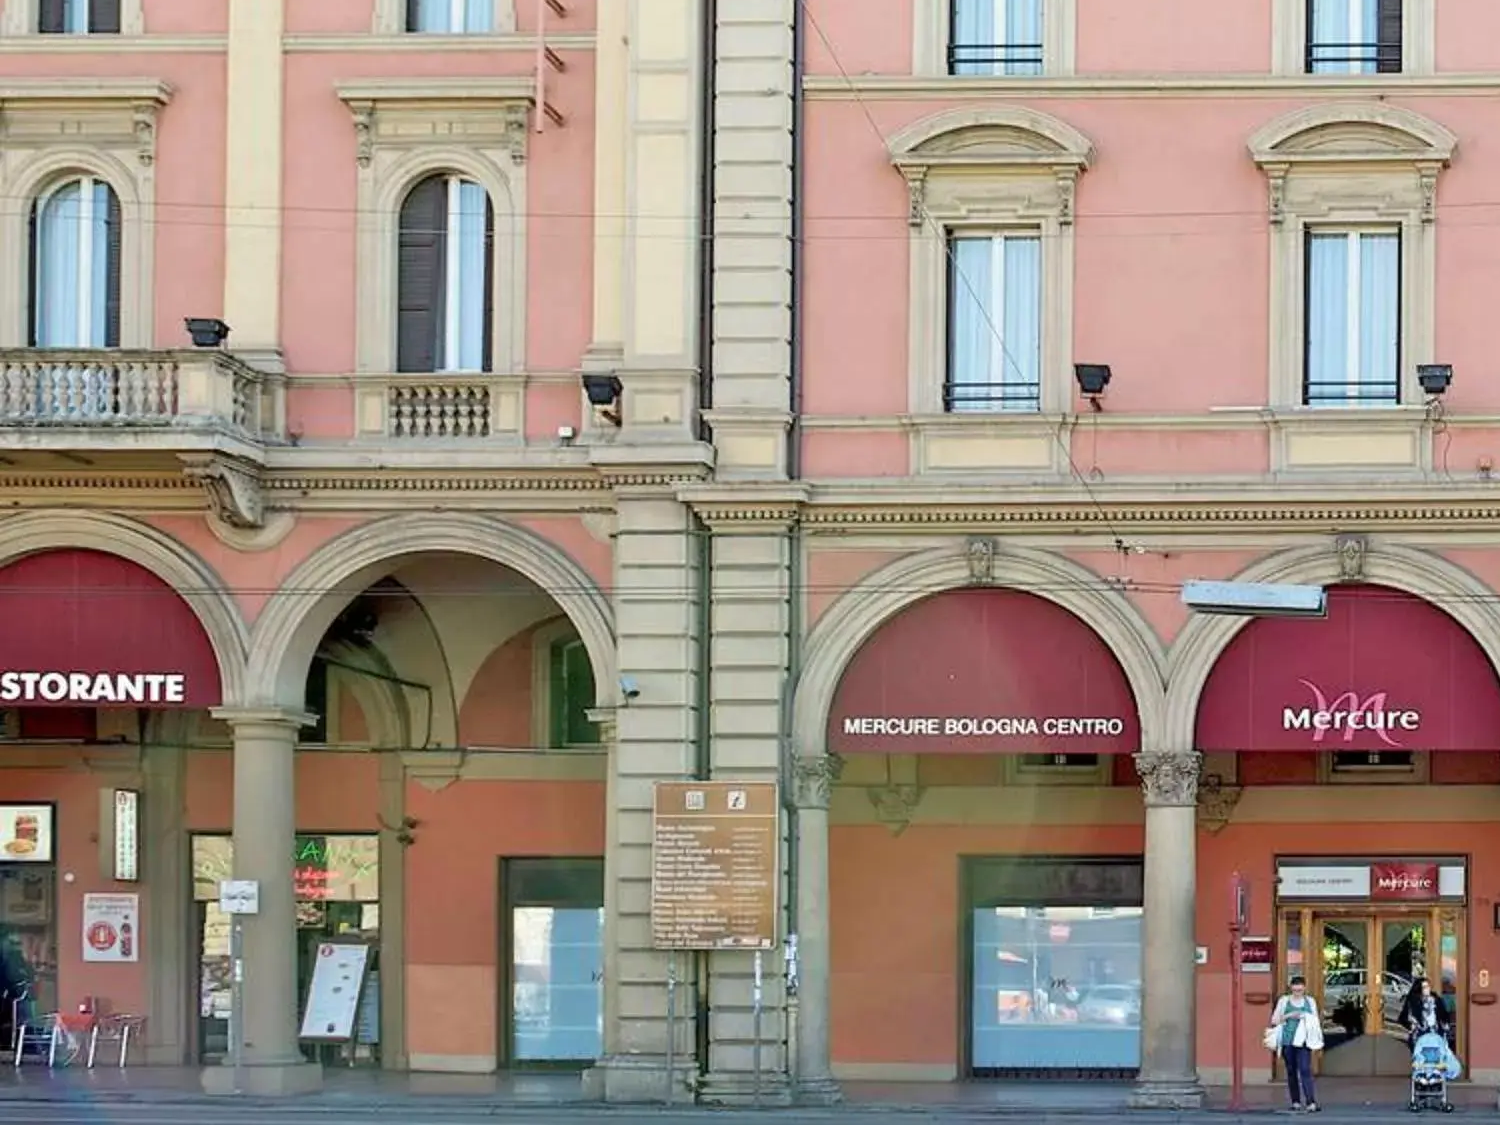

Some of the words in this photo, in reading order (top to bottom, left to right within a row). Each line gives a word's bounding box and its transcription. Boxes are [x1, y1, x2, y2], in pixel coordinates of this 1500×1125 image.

[0, 672, 185, 702] STORANTE
[844, 718, 939, 734] MERCURE
[944, 718, 1039, 734] BOLOGNA
[1043, 718, 1123, 734] CENTRO
[1283, 707, 1419, 730] Mercure
[1378, 877, 1432, 889] Mercure
